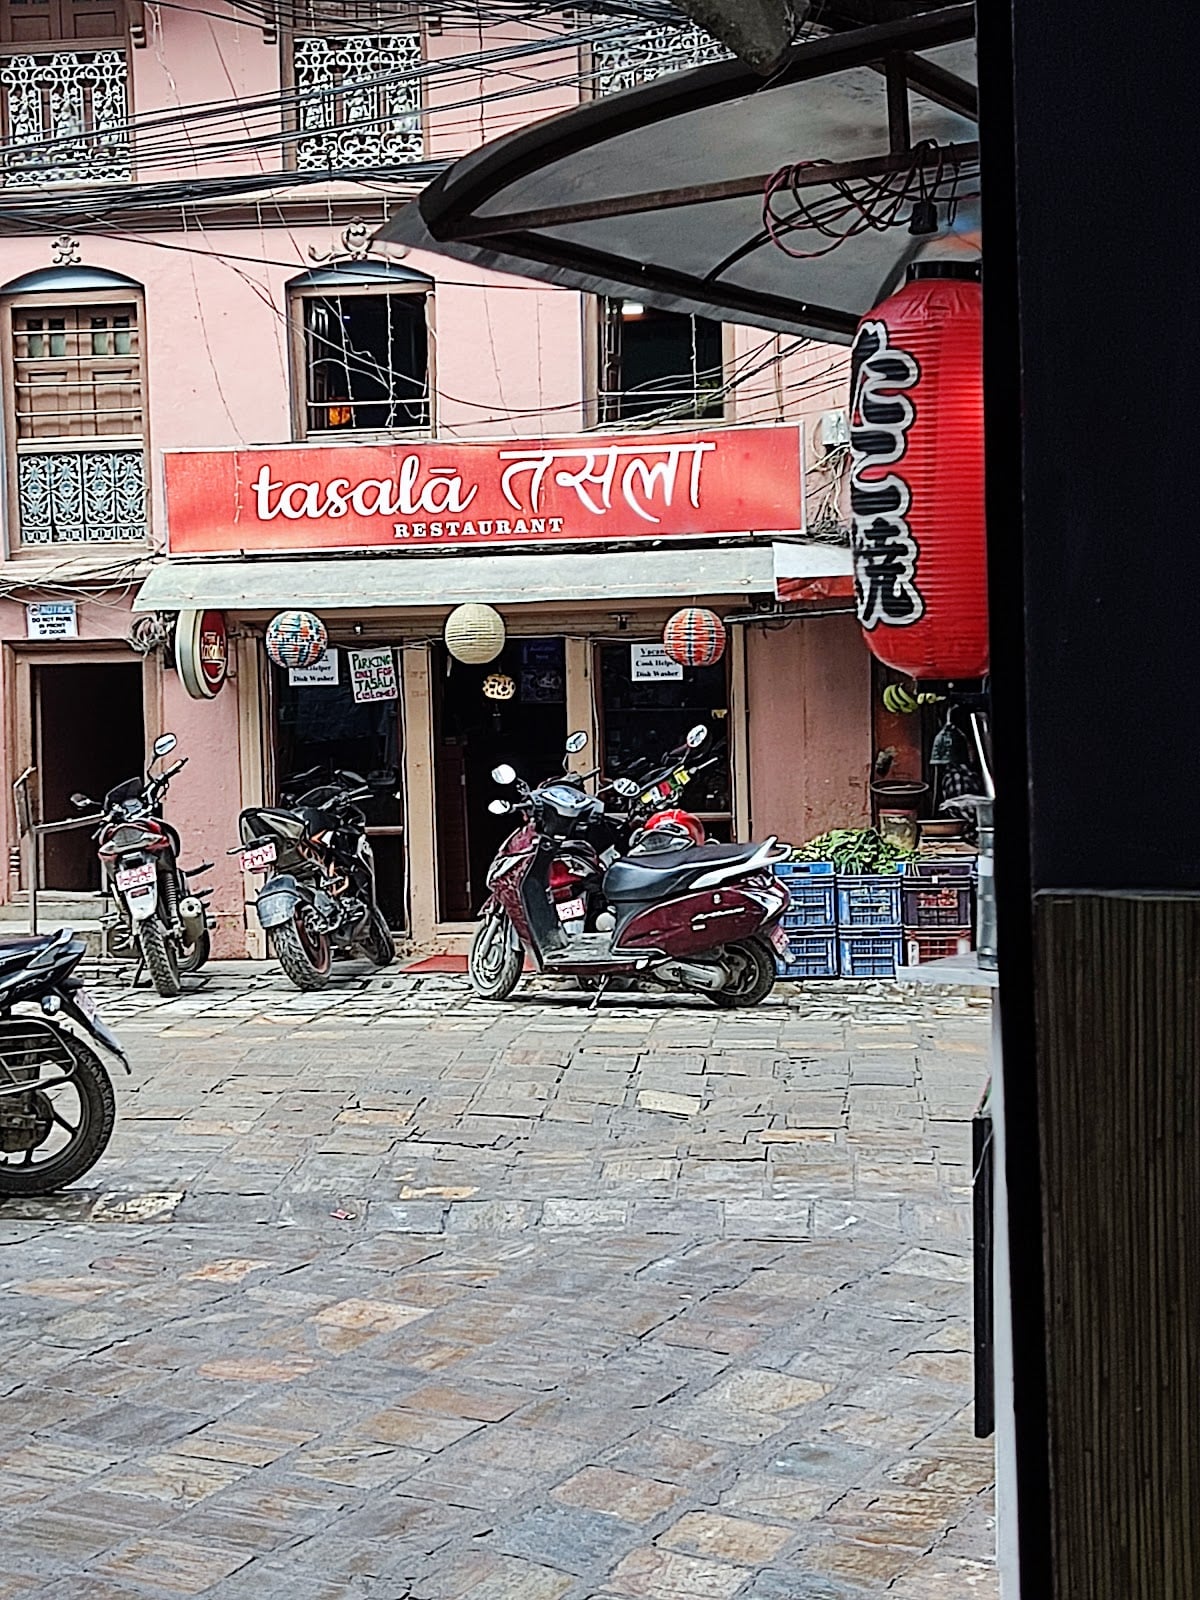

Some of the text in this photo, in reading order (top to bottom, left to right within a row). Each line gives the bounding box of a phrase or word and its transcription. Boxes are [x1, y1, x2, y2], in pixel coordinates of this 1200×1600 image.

[251, 454, 477, 521] tasalā
[499, 441, 717, 522] तसला
[393, 516, 564, 539] RESTAURANT
[352, 654, 392, 671] PARKING
[355, 676, 394, 692] TASALA
